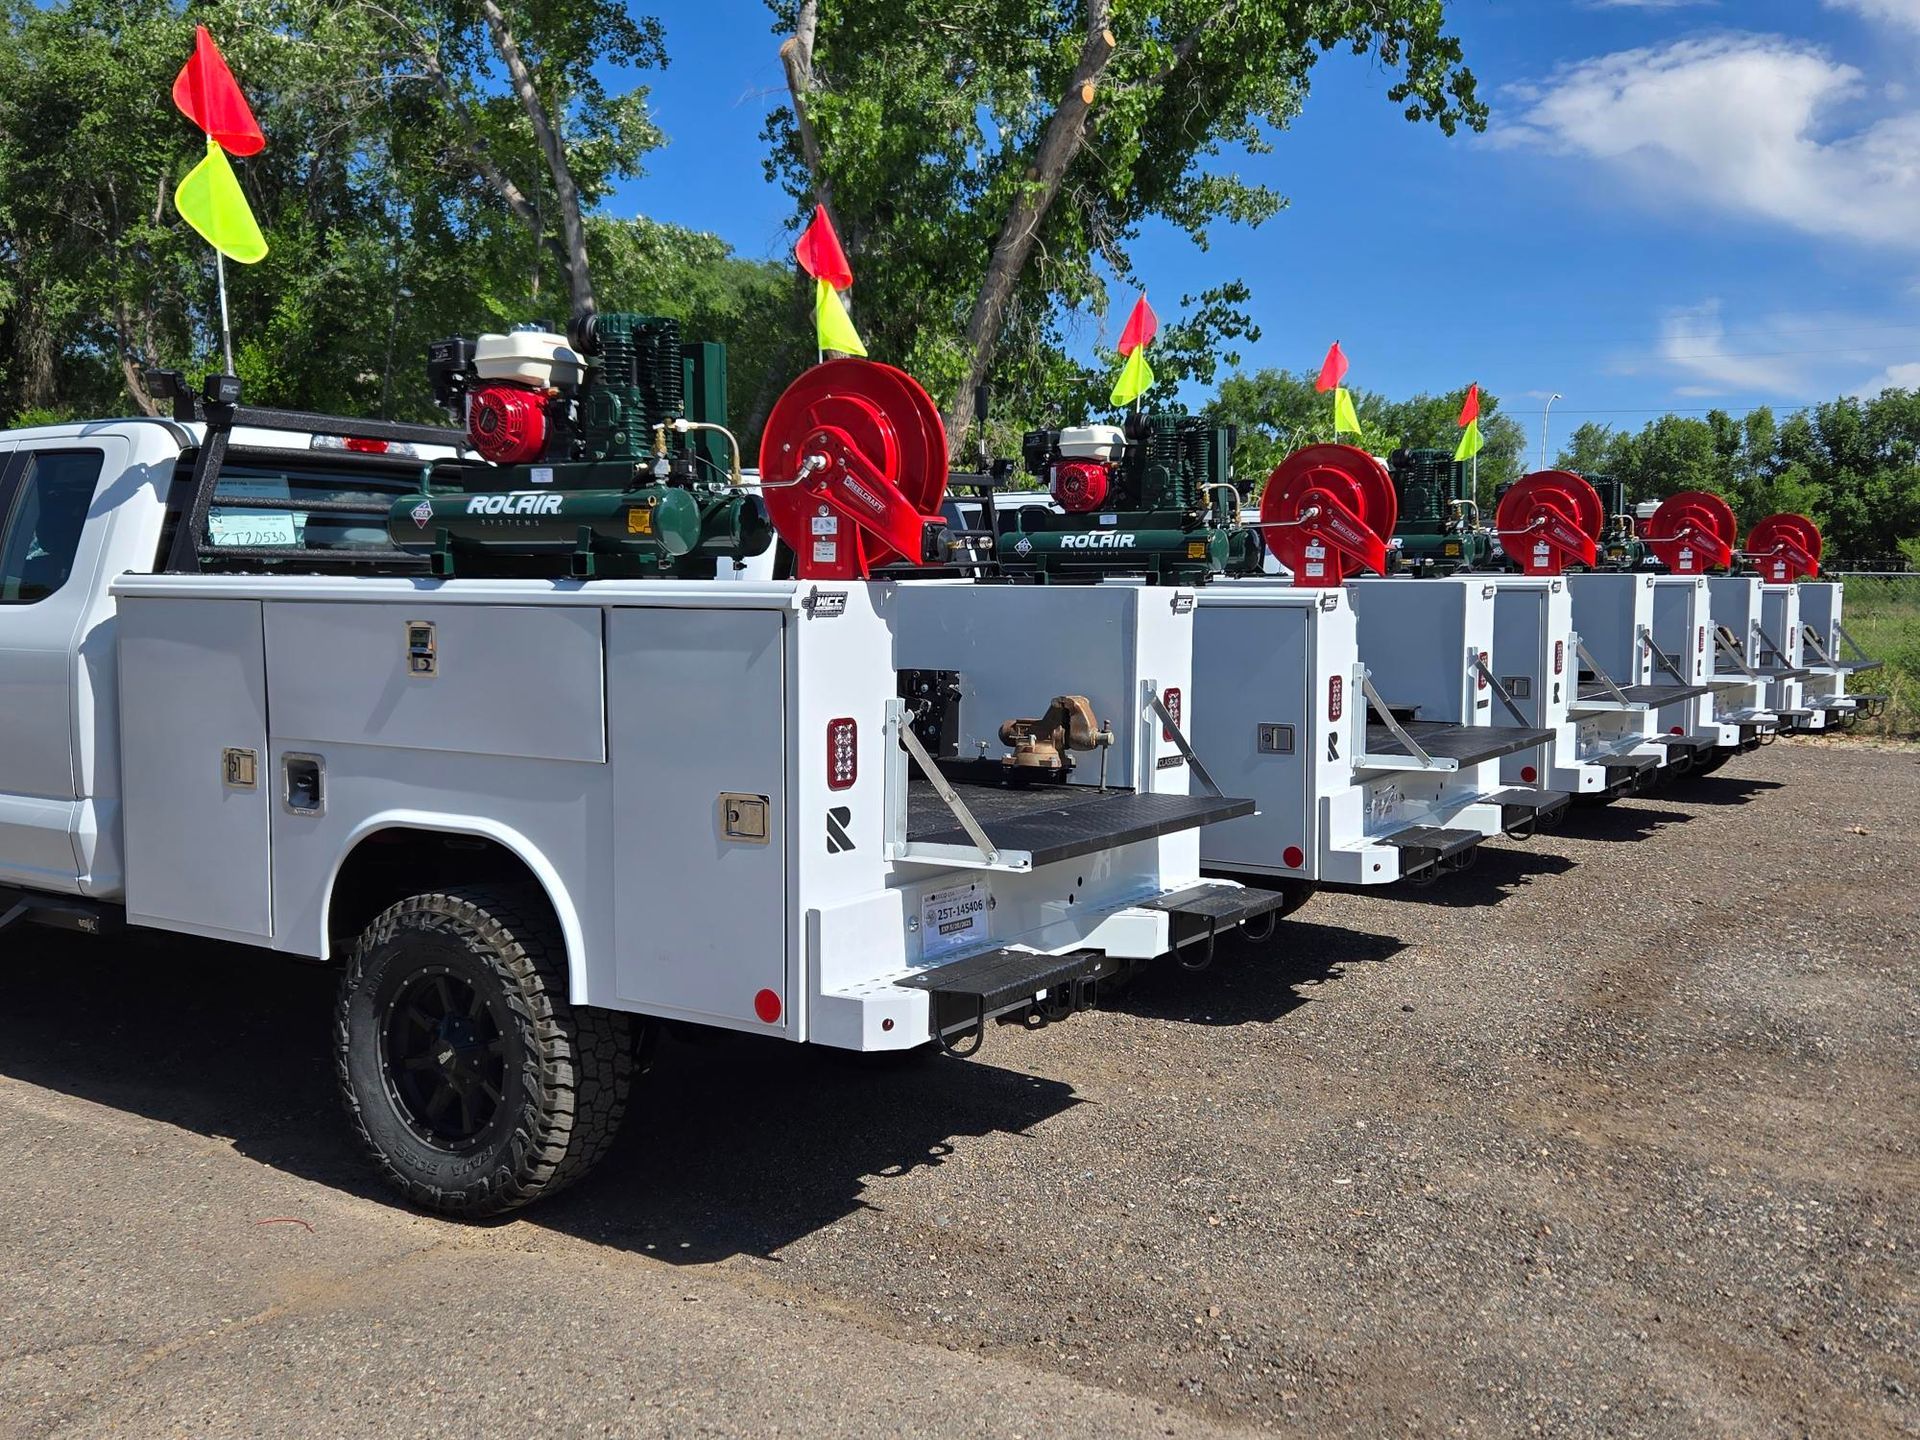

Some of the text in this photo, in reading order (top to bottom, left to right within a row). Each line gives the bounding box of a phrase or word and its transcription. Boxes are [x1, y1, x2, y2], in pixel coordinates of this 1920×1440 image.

[466, 494, 561, 515] ROLAIR
[848, 479, 884, 511] REELCRAFT
[480, 518, 540, 527] SYSTEMS
[1060, 534, 1135, 549] ROLAIR
[937, 899, 983, 921] 25T-145406
